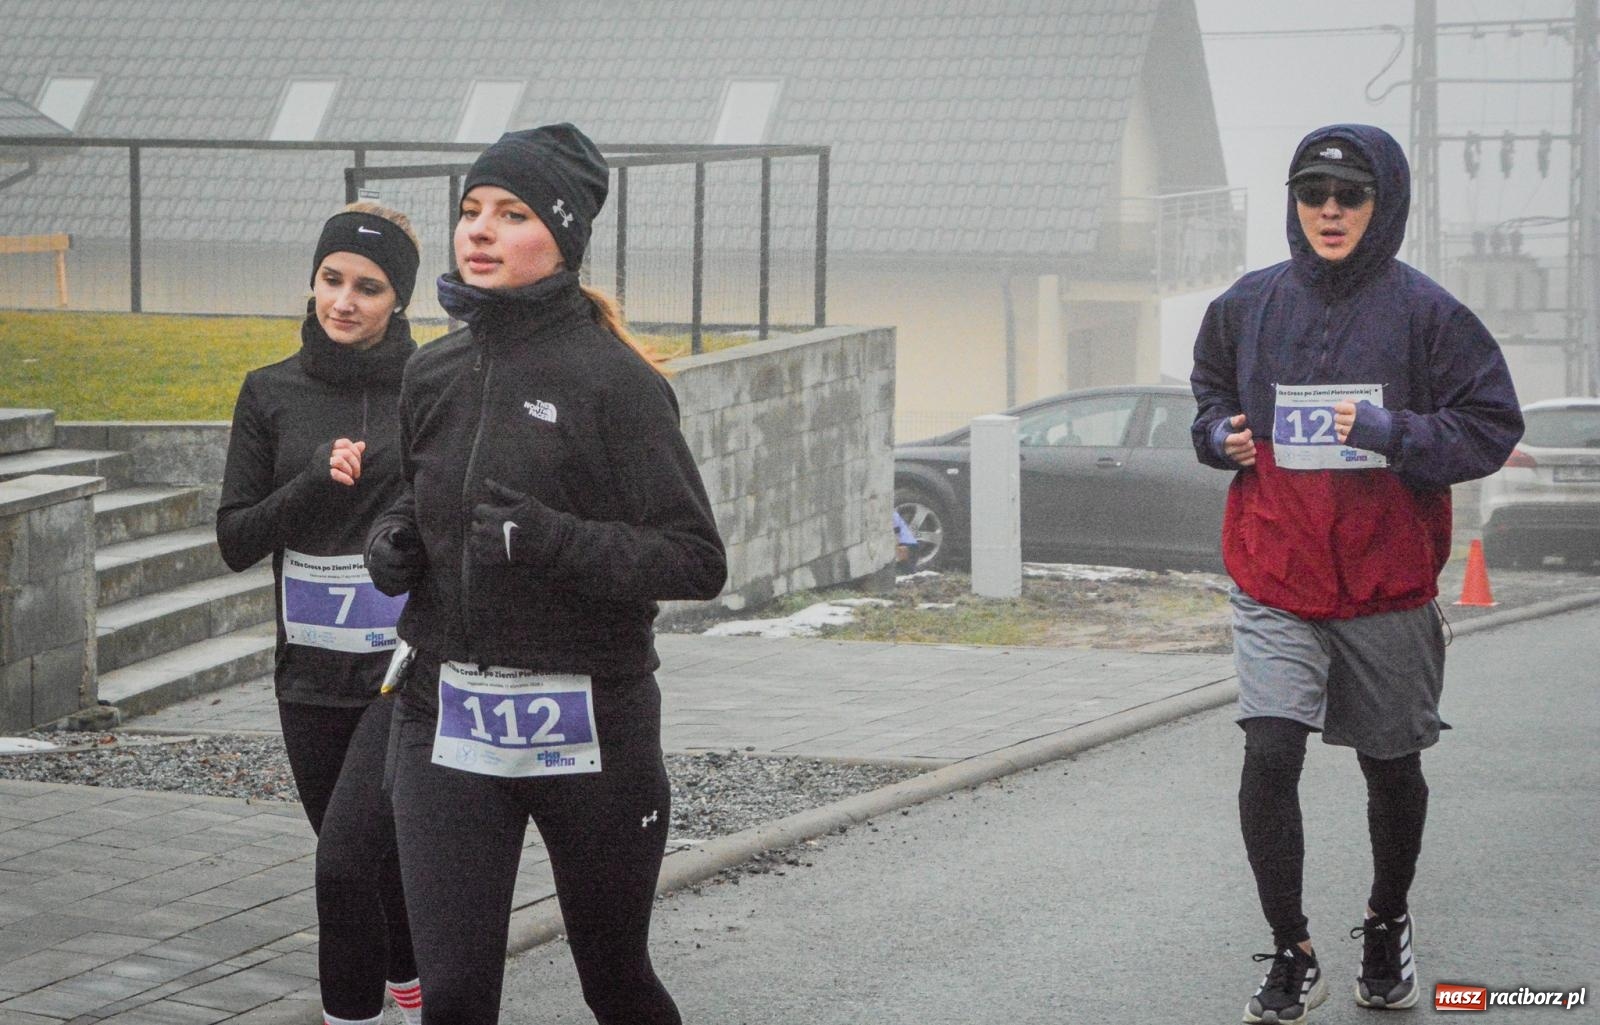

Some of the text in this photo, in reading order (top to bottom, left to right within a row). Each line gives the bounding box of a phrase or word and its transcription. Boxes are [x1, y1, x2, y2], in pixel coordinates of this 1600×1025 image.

[1286, 408, 1335, 443] 12
[328, 586, 356, 625] 7
[460, 668, 483, 676] Cross
[484, 671, 494, 679] po
[494, 671, 517, 679] Ziemi
[463, 695, 565, 745] 112
